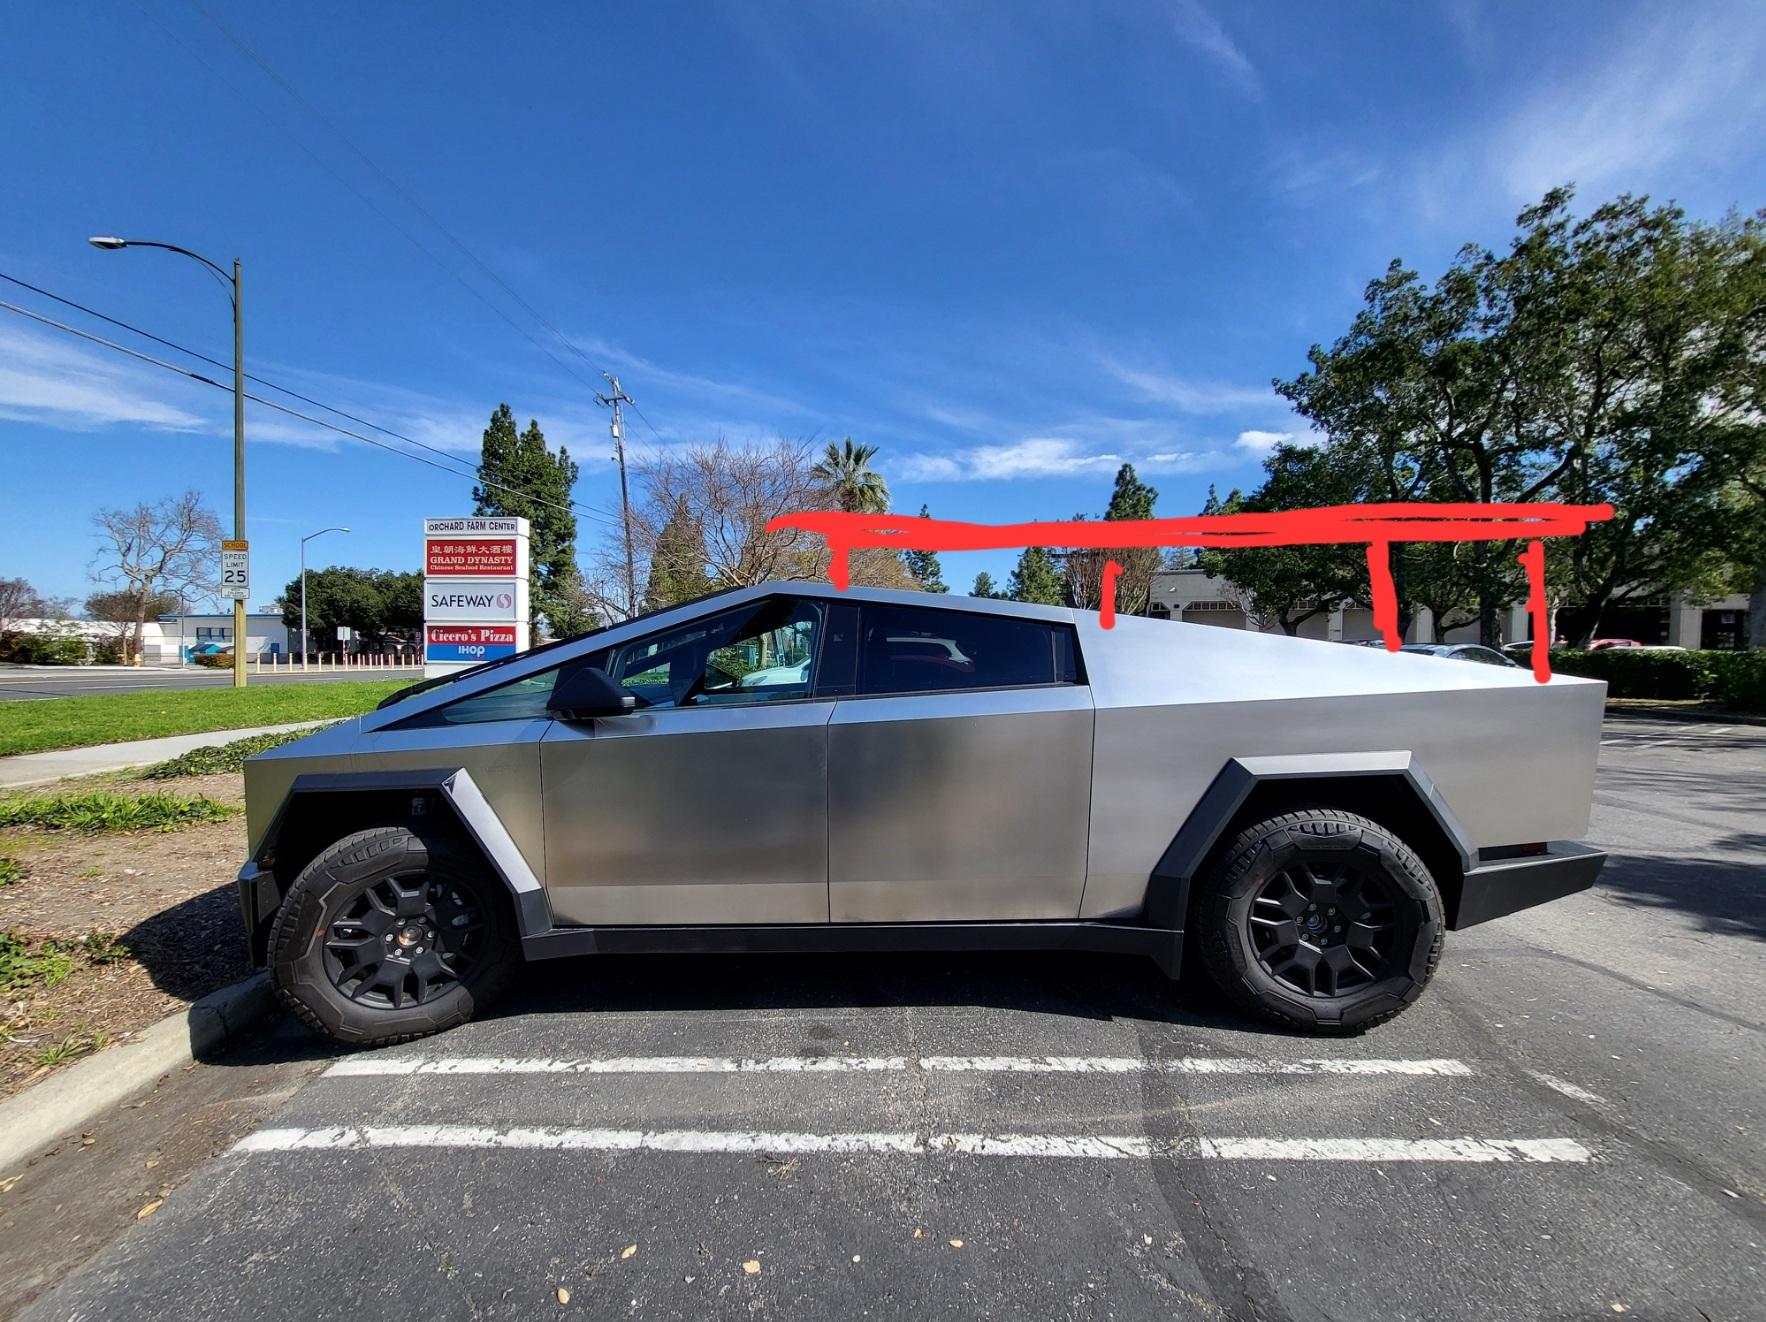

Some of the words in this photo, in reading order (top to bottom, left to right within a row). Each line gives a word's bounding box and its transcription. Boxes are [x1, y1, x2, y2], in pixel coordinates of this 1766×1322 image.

[428, 522, 464, 531] ORCHARD
[467, 521, 486, 530] FARM
[489, 522, 515, 530] CENTER
[224, 570, 246, 583] 25
[431, 594, 494, 607] SAFEWAY
[431, 629, 476, 642] Cicero's
[480, 629, 513, 642] Pizza
